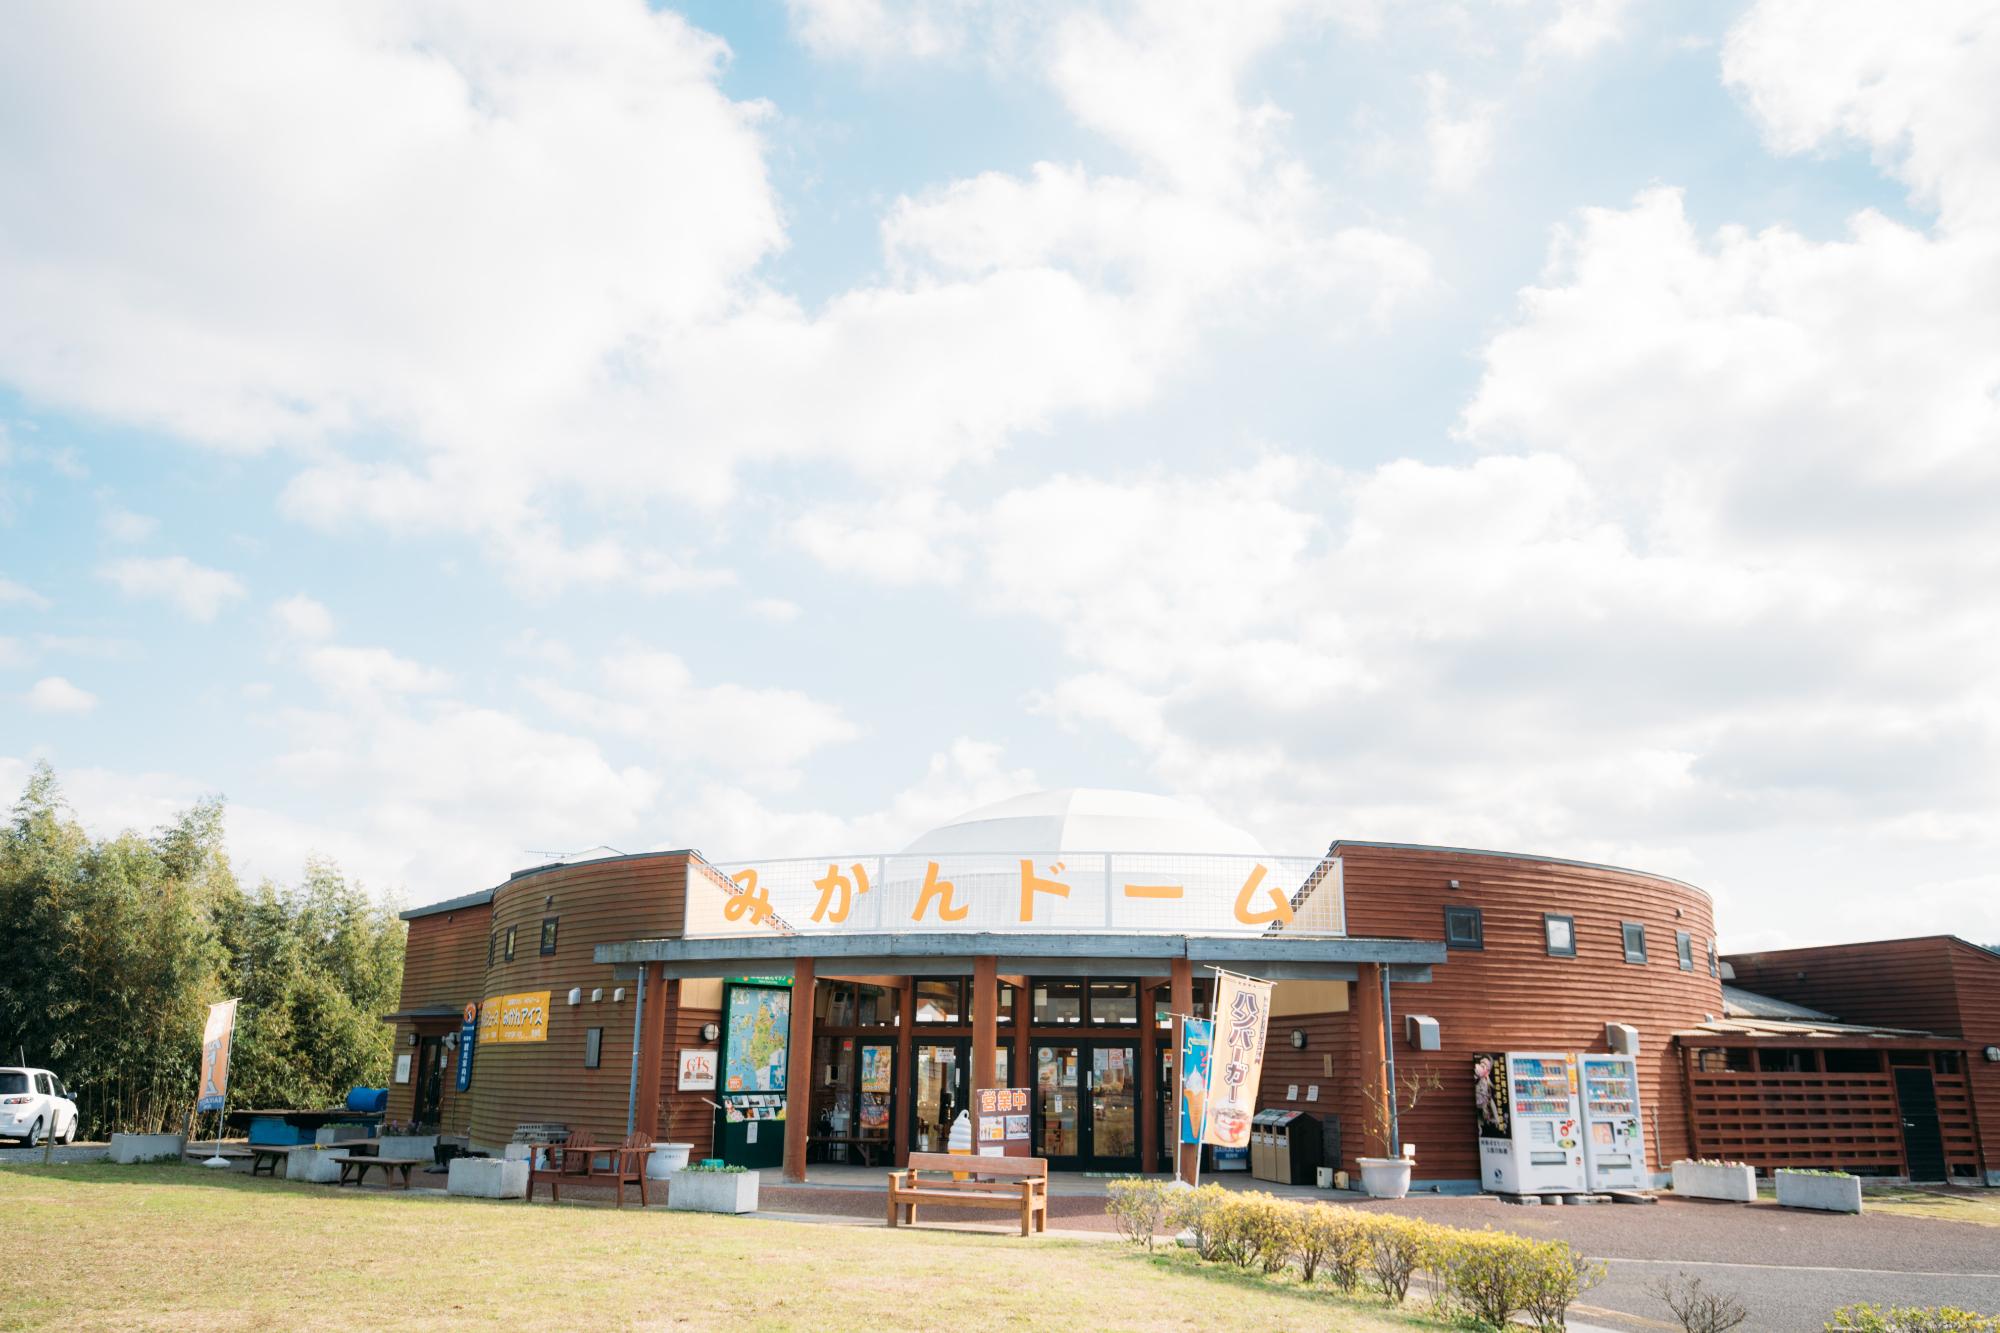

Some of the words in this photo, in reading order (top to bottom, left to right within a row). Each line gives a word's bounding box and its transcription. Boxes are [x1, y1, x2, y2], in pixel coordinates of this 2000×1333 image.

[724, 859, 1294, 925] みかんドーム
[1224, 991, 1260, 1104] ハンバーガー
[981, 1089, 1027, 1113] 営業中
